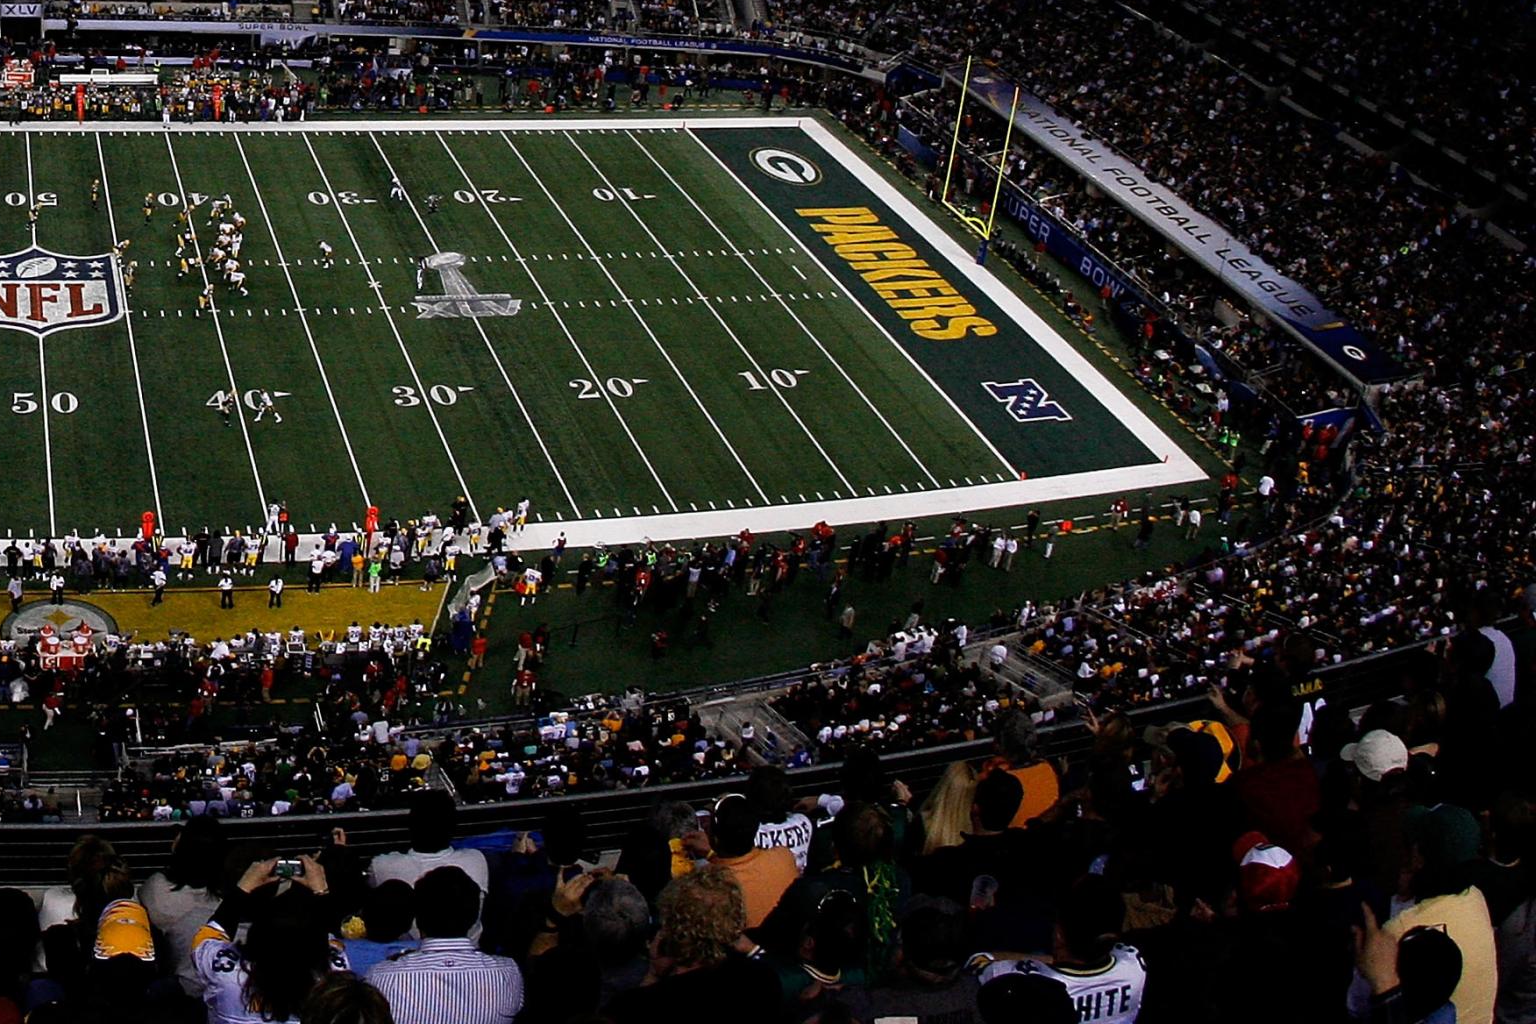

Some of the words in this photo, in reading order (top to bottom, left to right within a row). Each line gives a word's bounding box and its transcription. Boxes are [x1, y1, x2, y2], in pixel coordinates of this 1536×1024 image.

[5, 4, 38, 16] XLV
[238, 23, 274, 31] SUPER
[279, 24, 310, 32] BOWL
[588, 36, 628, 45] NATIONAL
[631, 38, 672, 48] FOOTBALL
[674, 40, 706, 49] LEAGUE
[4, 191, 59, 208] 50
[307, 190, 361, 206] 30
[452, 189, 511, 205] 20
[591, 187, 645, 202] 10
[1016, 102, 1103, 164] NATIONAL
[1103, 167, 1214, 245] FOOTBALL
[1215, 248, 1314, 318] LEAGUE
[794, 206, 999, 341] PACKERS
[409, 299, 522, 320] XLV
[10, 390, 79, 415] 50
[392, 384, 458, 408] 30
[568, 377, 635, 400] 20
[737, 367, 798, 391] 10
[760, 821, 811, 850] CKERS
[1076, 984, 1132, 1023] HITE
